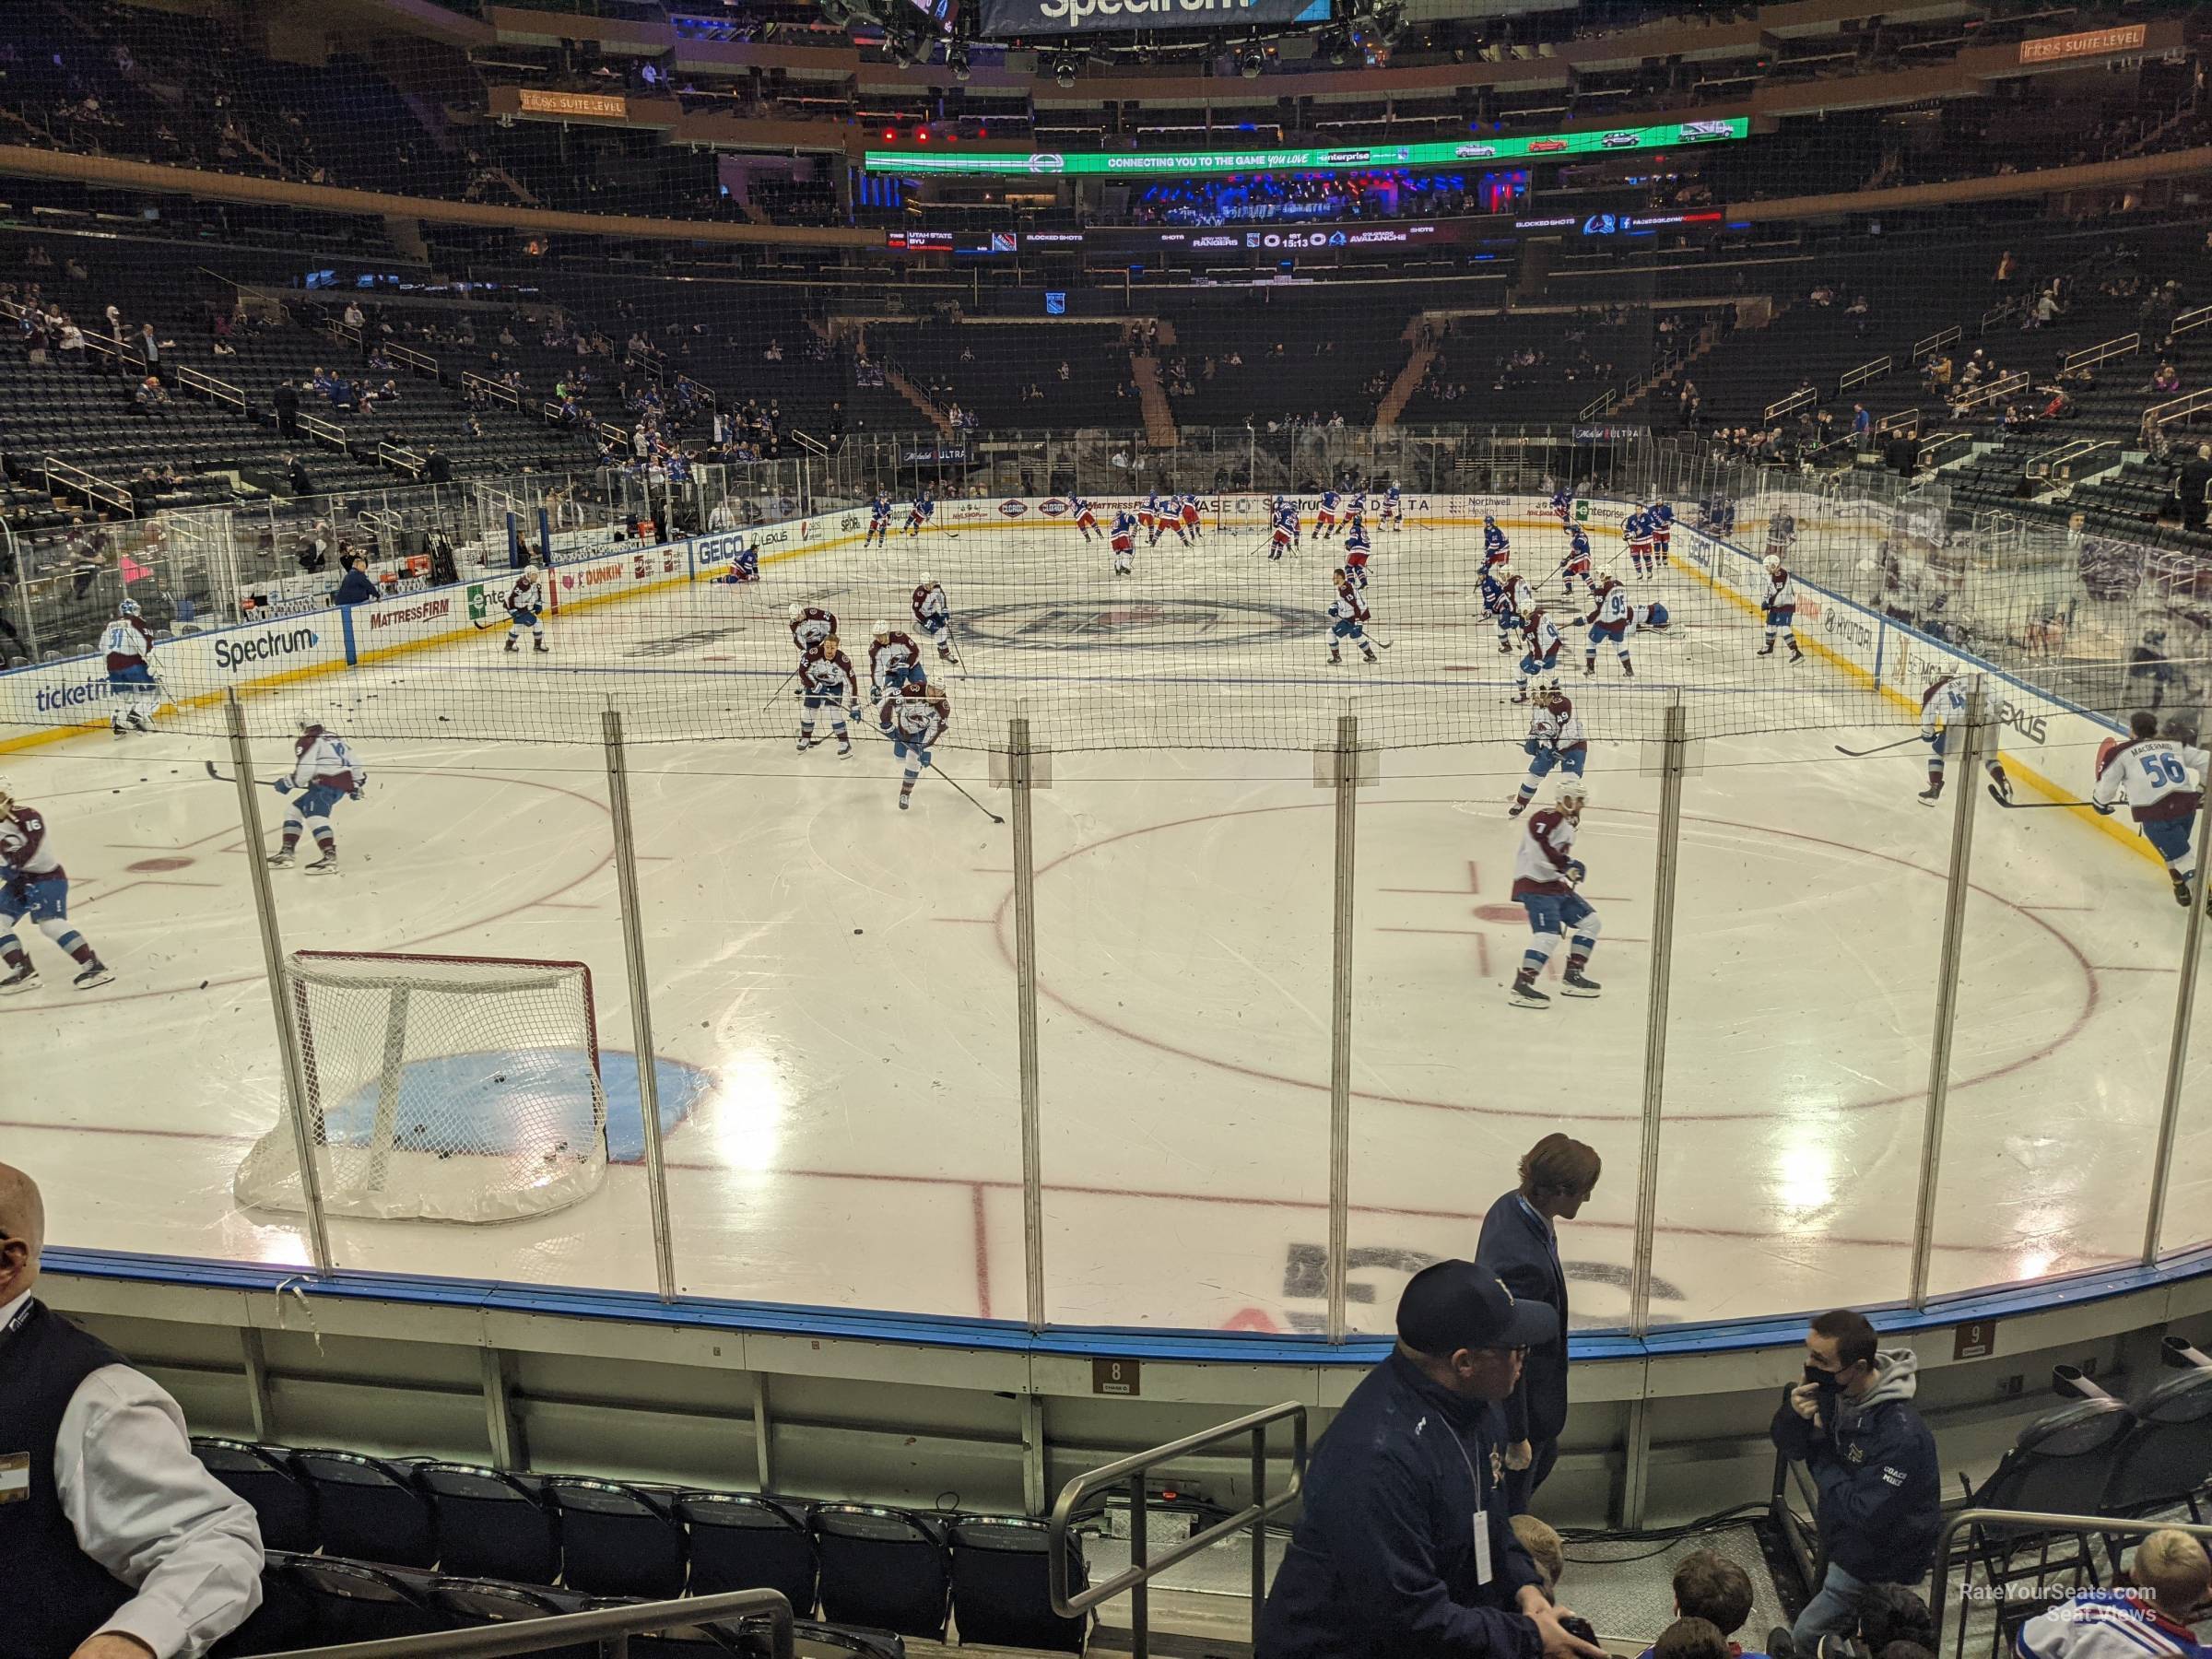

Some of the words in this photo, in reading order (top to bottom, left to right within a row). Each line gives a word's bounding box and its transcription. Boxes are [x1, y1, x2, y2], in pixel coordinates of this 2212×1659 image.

[2065, 38, 2100, 52] SUITE
[2103, 31, 2139, 46] LEVEL
[559, 99, 590, 110] SUITE
[593, 101, 623, 112] LEVEL
[1108, 158, 1175, 168] CONNECTING
[1176, 157, 1196, 167] YOU
[1198, 157, 1212, 166] TO
[1214, 157, 1234, 166] THE
[1236, 156, 1265, 165] GAME
[1267, 155, 1285, 168] YOU
[1287, 154, 1309, 164] LOVE
[1318, 151, 1371, 163] enterprise
[1350, 234, 1406, 243] AVALANCHE
[1002, 505, 1024, 513] CLOROX
[1042, 504, 1065, 512] CLOROX
[1468, 497, 1511, 506] Northwell
[1579, 505, 1625, 520] enterprise
[761, 531, 788, 546] LEXUS
[700, 535, 744, 565] GEICO
[586, 563, 624, 585] DUNKIN'
[1611, 595, 1626, 616] 95
[1837, 615, 1872, 652] HYUNDAI
[215, 629, 313, 674] Spectrum
[36, 676, 113, 712] ticketm
[1999, 700, 2047, 746] EXUS
[2139, 751, 2185, 789] 56
[25, 818, 42, 832] 16
[1535, 822, 1547, 834] 7
[1971, 1325, 1980, 1343] 9
[1112, 1362, 1122, 1381] 8
[1882, 1474, 1903, 1487] MIKE
